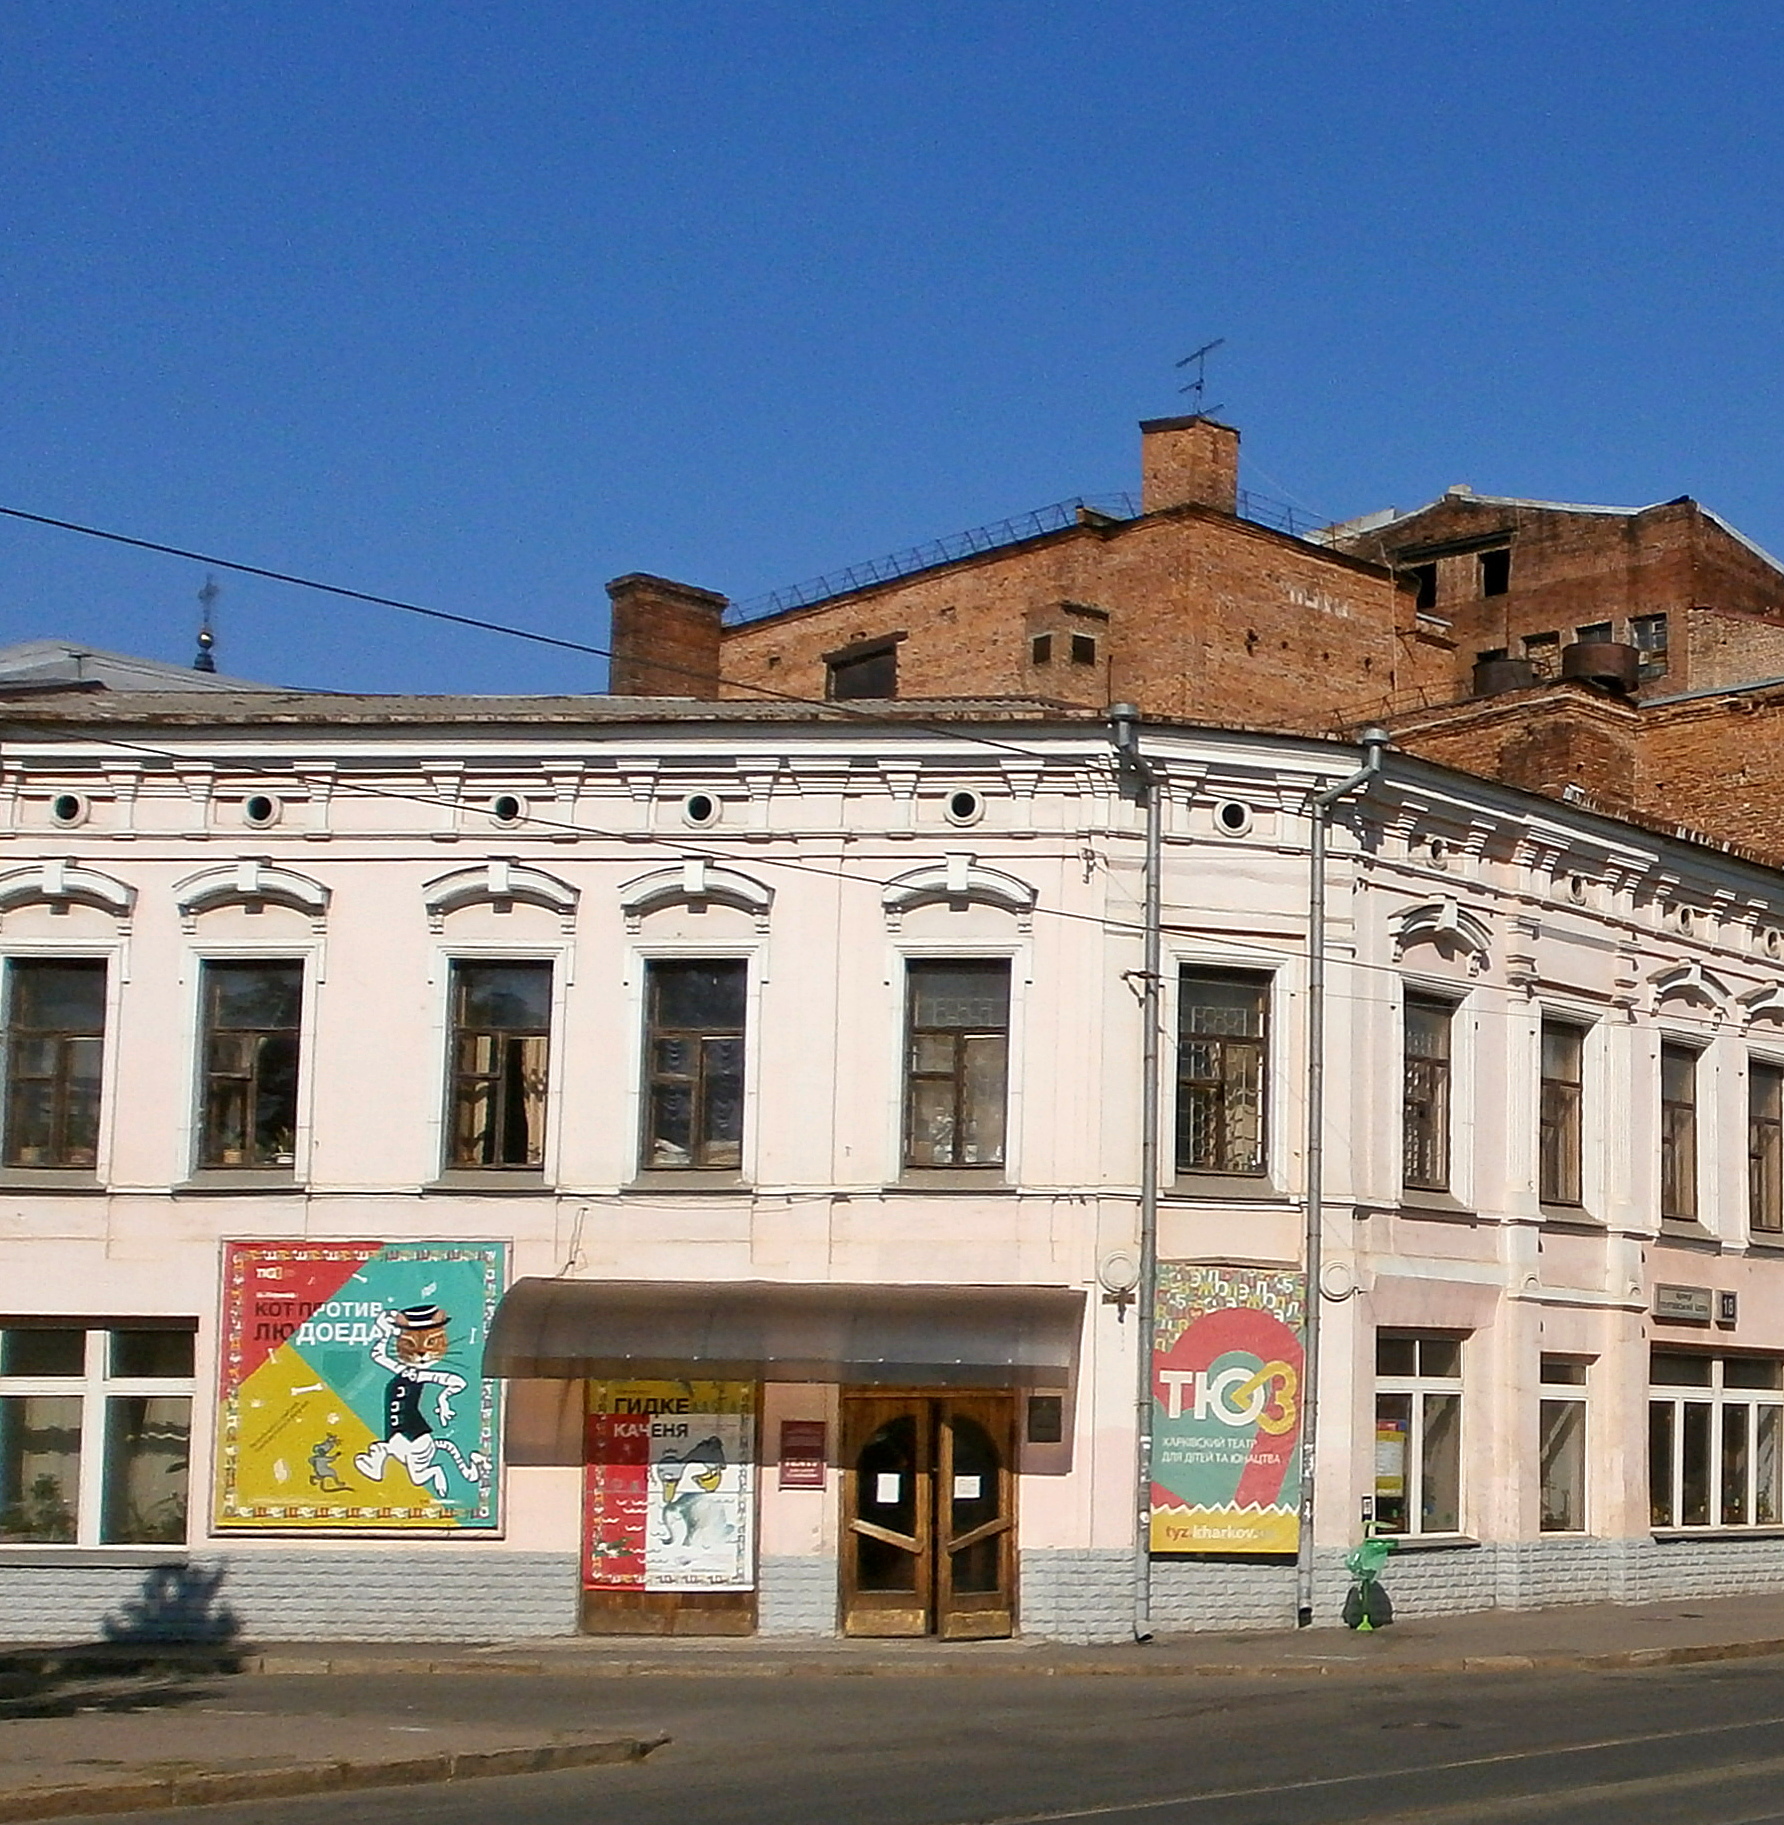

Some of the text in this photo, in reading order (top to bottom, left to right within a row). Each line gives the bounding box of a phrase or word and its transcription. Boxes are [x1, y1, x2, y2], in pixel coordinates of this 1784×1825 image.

[254, 1302, 384, 1319] КОТ ПРОТИВ
[253, 1323, 386, 1346] ЛЮДОЕДА
[613, 1398, 690, 1419] ГИДКЕ
[613, 1422, 689, 1439] КАЧЕНЯ
[1226, 1438, 1258, 1449] ТЕАТР
[1161, 1451, 1183, 1463] ДЛЯ
[1215, 1452, 1229, 1463] ТА
